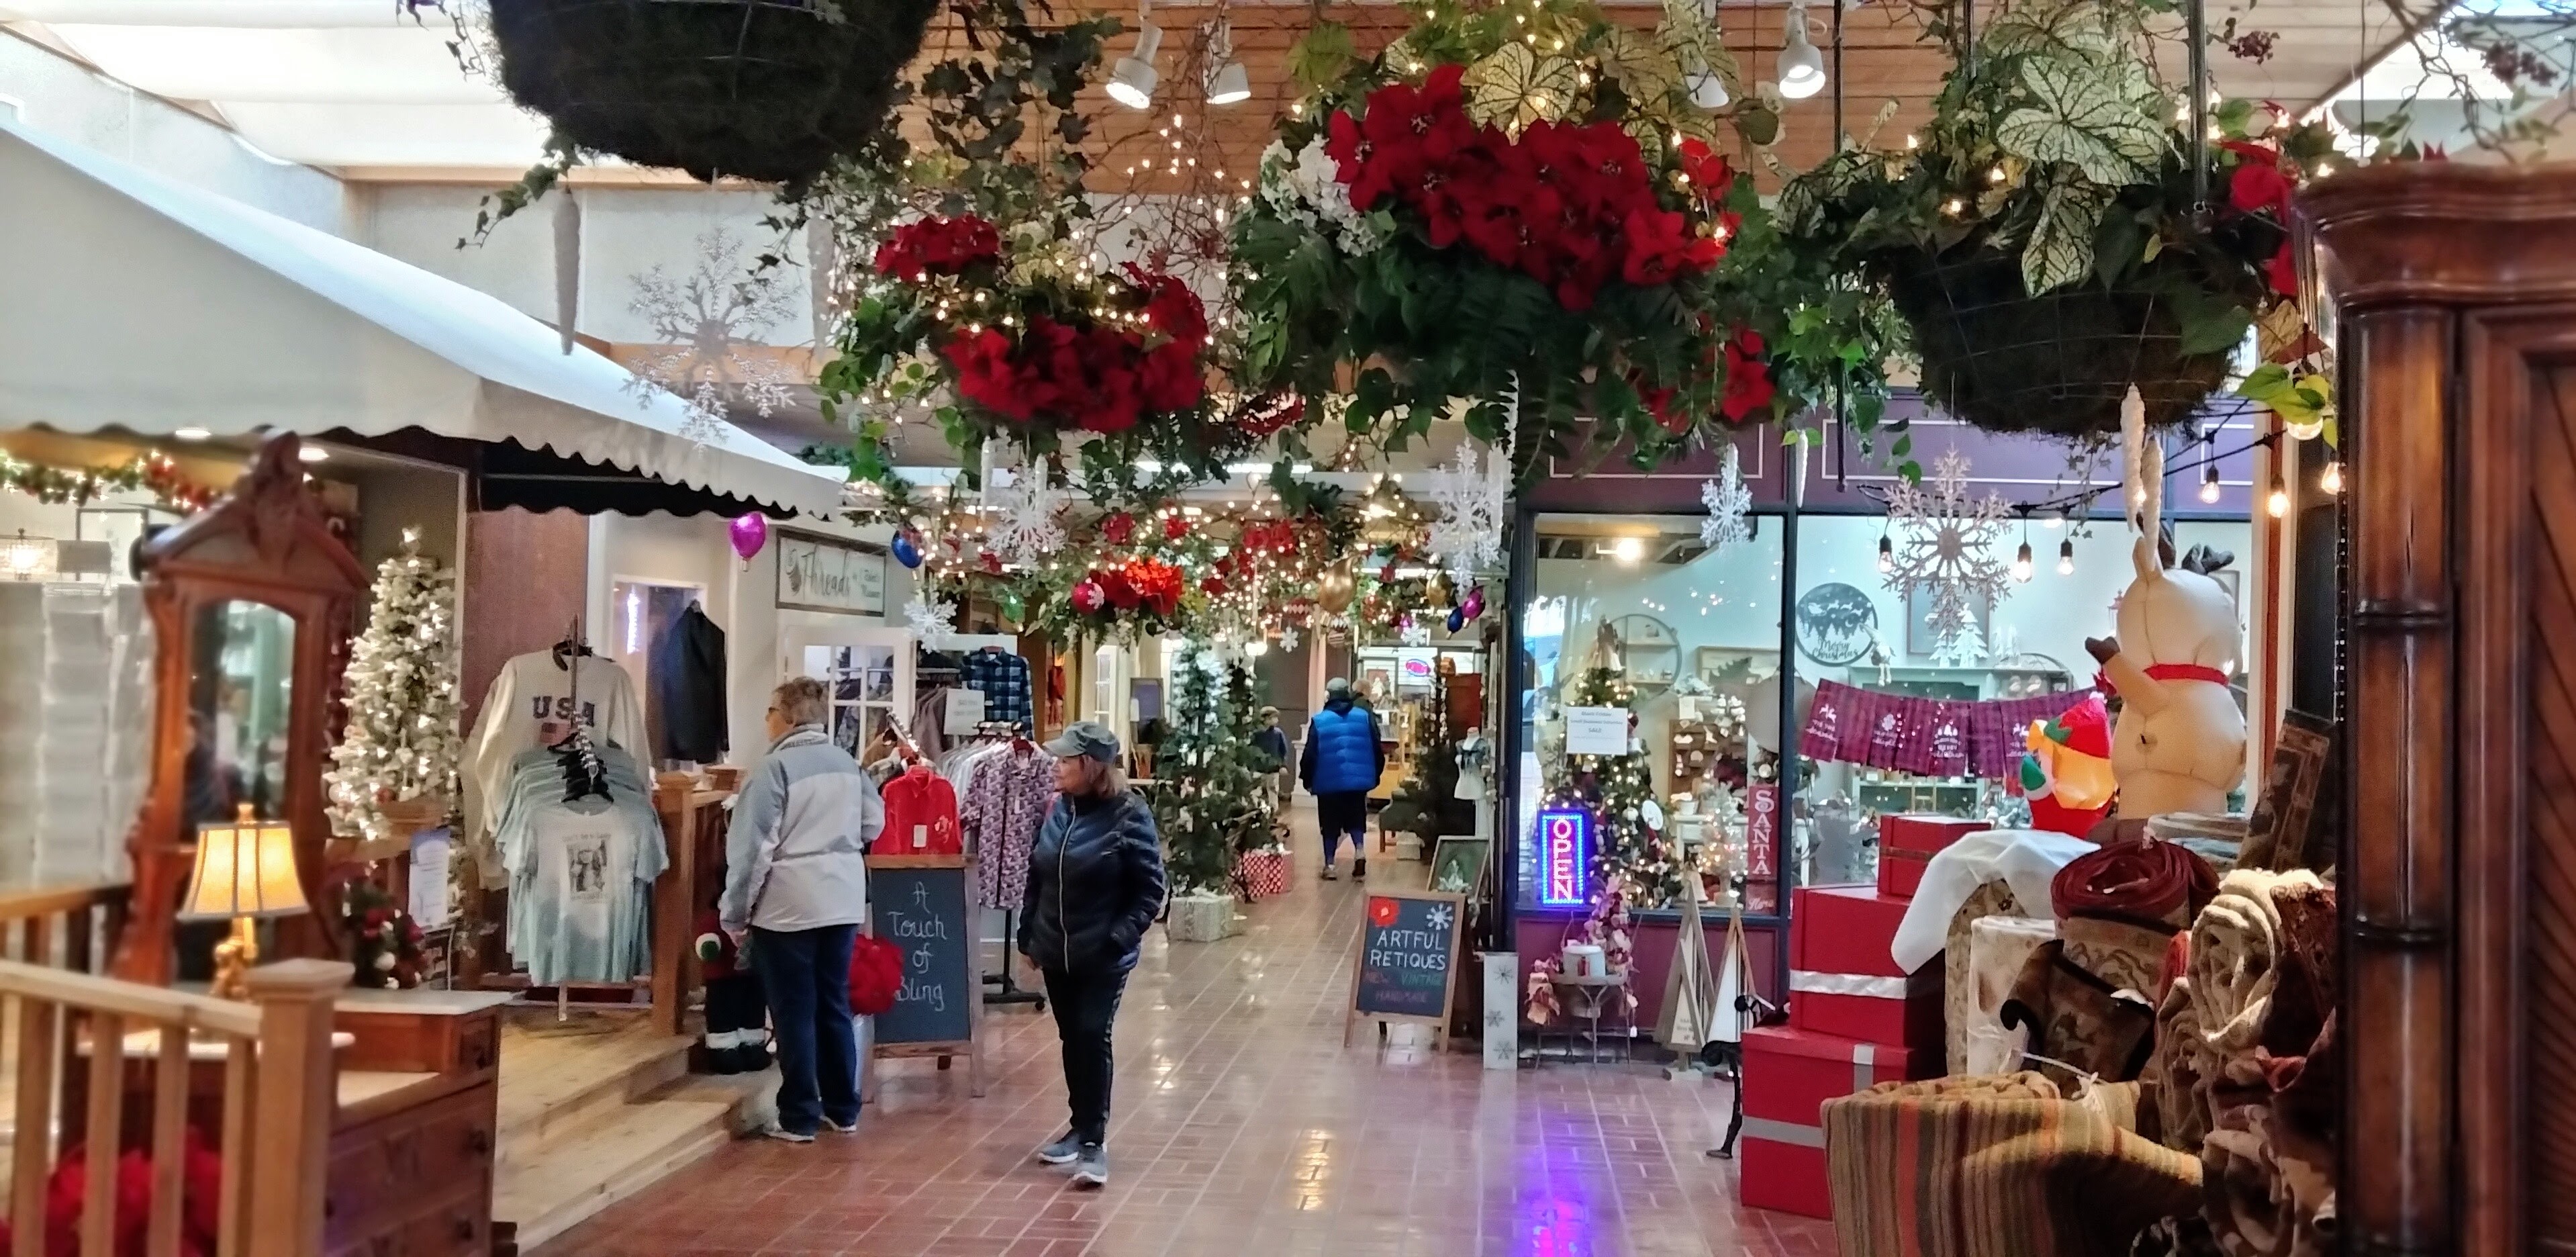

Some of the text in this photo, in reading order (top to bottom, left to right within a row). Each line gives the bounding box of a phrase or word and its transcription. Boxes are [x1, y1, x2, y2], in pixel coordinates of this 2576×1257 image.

[1752, 790, 1774, 875] SANTA
[1553, 819, 1572, 900] OPEN
[913, 881, 931, 913] A
[888, 911, 947, 940] Touch
[1376, 929, 1445, 951] ARTFUL
[913, 942, 934, 974] of
[1370, 949, 1446, 971] RETIQUES
[894, 975, 945, 1012] Bling
